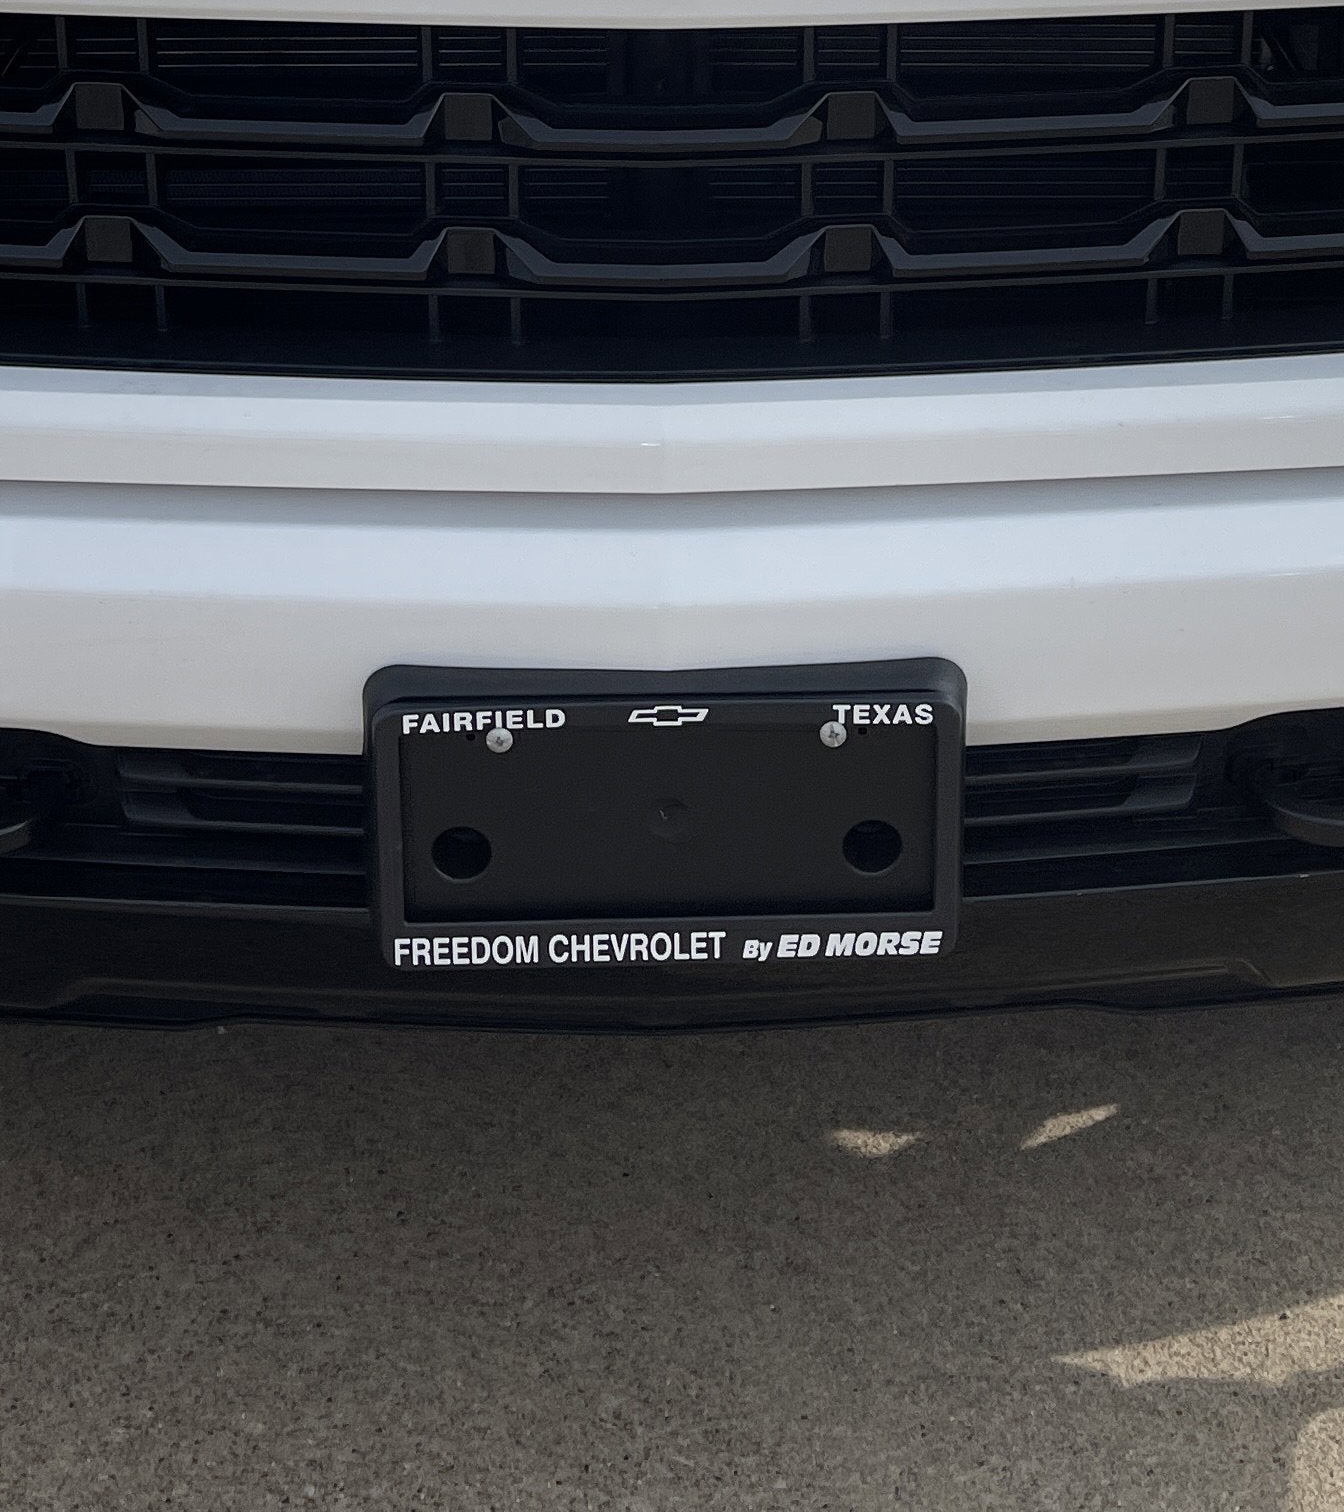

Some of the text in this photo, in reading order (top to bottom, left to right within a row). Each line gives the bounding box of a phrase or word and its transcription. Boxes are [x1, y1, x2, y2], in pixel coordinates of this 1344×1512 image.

[402, 708, 566, 735] FAIRFIELD
[832, 703, 935, 726] TEXAS
[393, 930, 944, 967] FREEDOM CHEVROLET By ED MORSE
